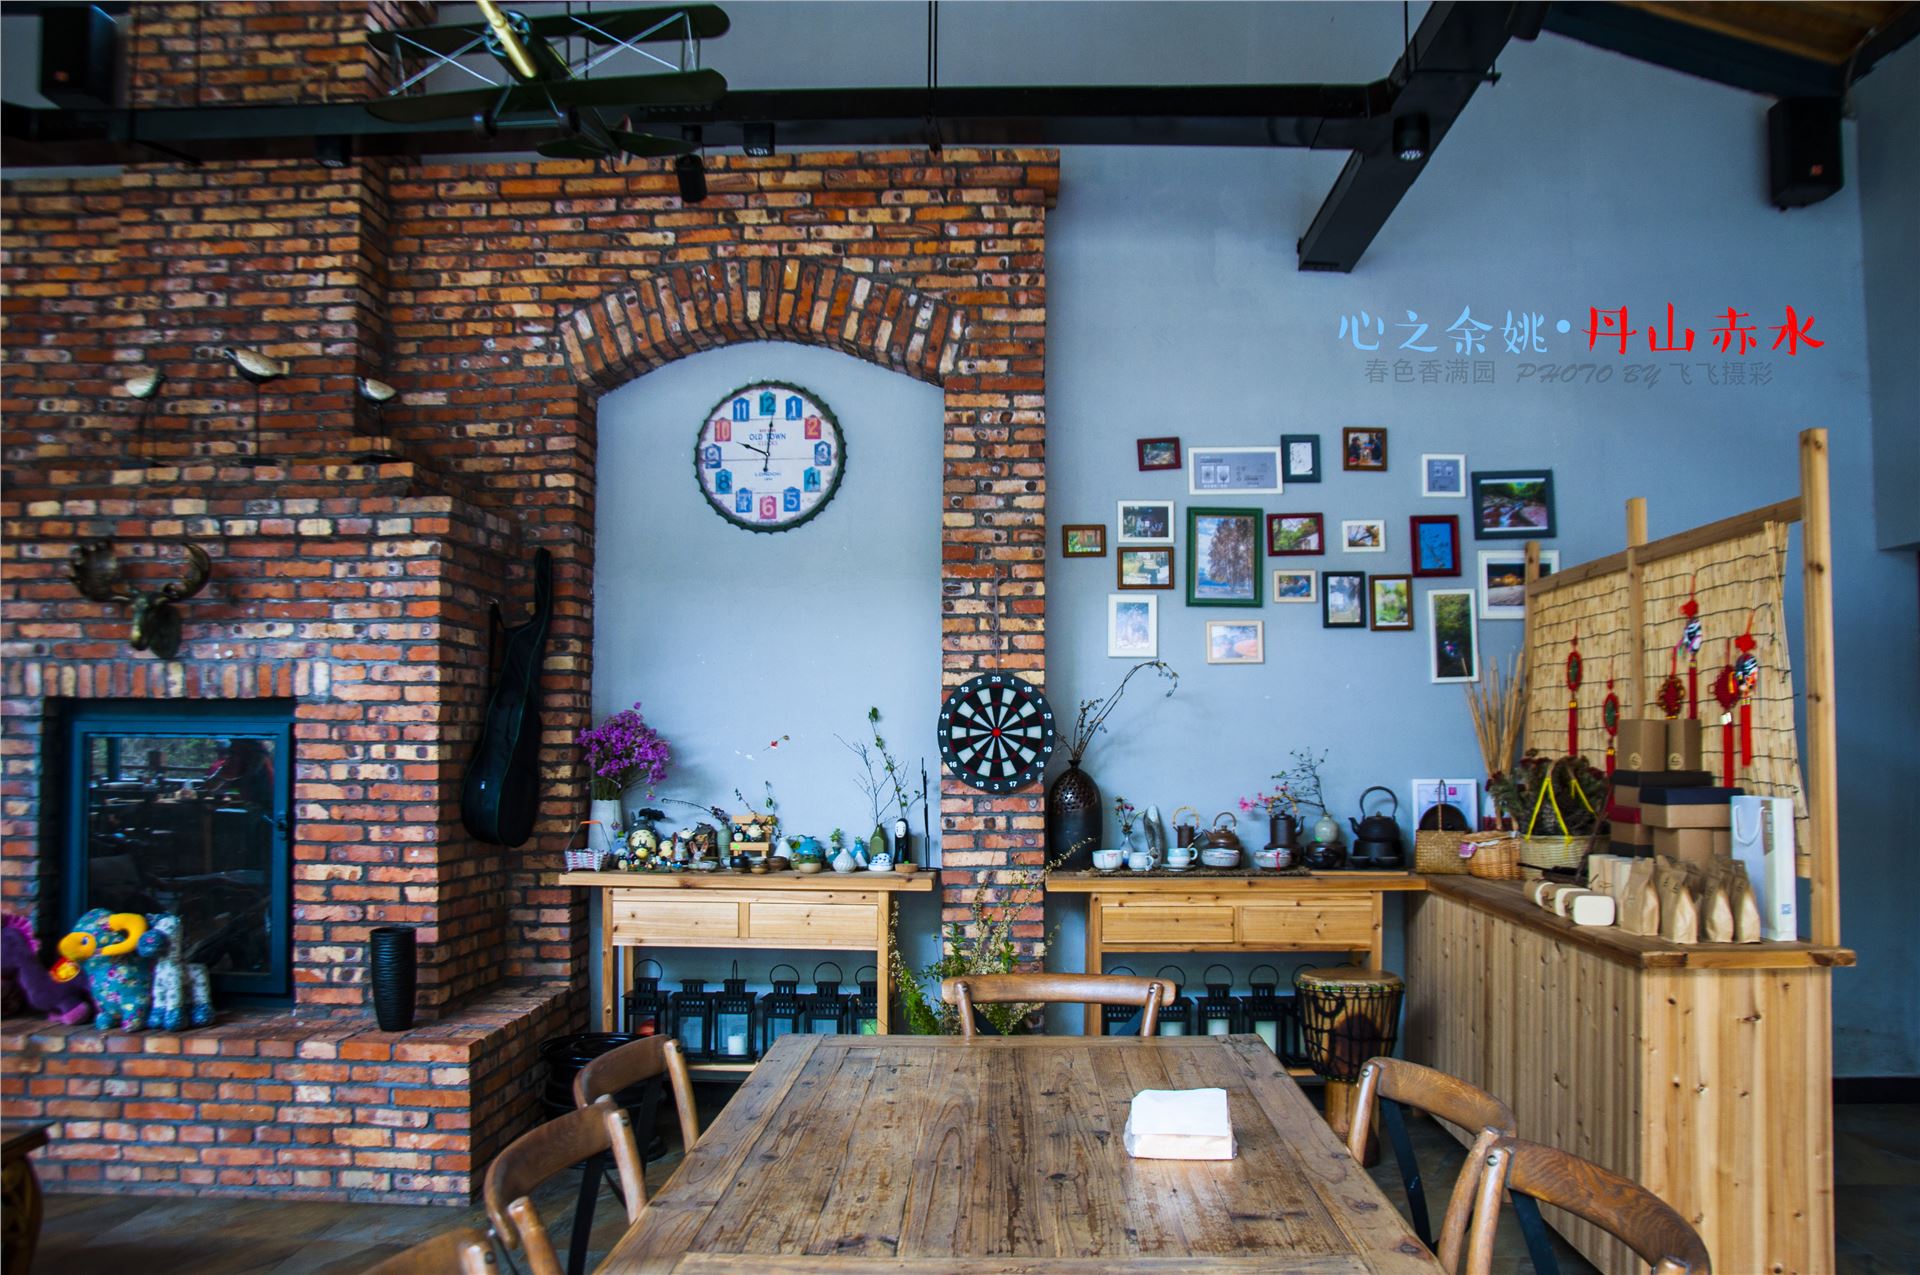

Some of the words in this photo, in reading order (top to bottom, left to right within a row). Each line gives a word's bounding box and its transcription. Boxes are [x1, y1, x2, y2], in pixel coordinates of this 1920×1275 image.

[735, 402, 747, 420] 11
[761, 396, 776, 414] 12
[790, 400, 797, 418] 1
[715, 421, 729, 439] 10
[808, 419, 819, 436] 2
[749, 433, 763, 441] OLD
[708, 446, 720, 464] 9
[817, 444, 828, 462] 3
[718, 473, 730, 488] 8
[807, 471, 817, 487] 4
[762, 498, 773, 515] 6
[786, 493, 797, 509] 5
